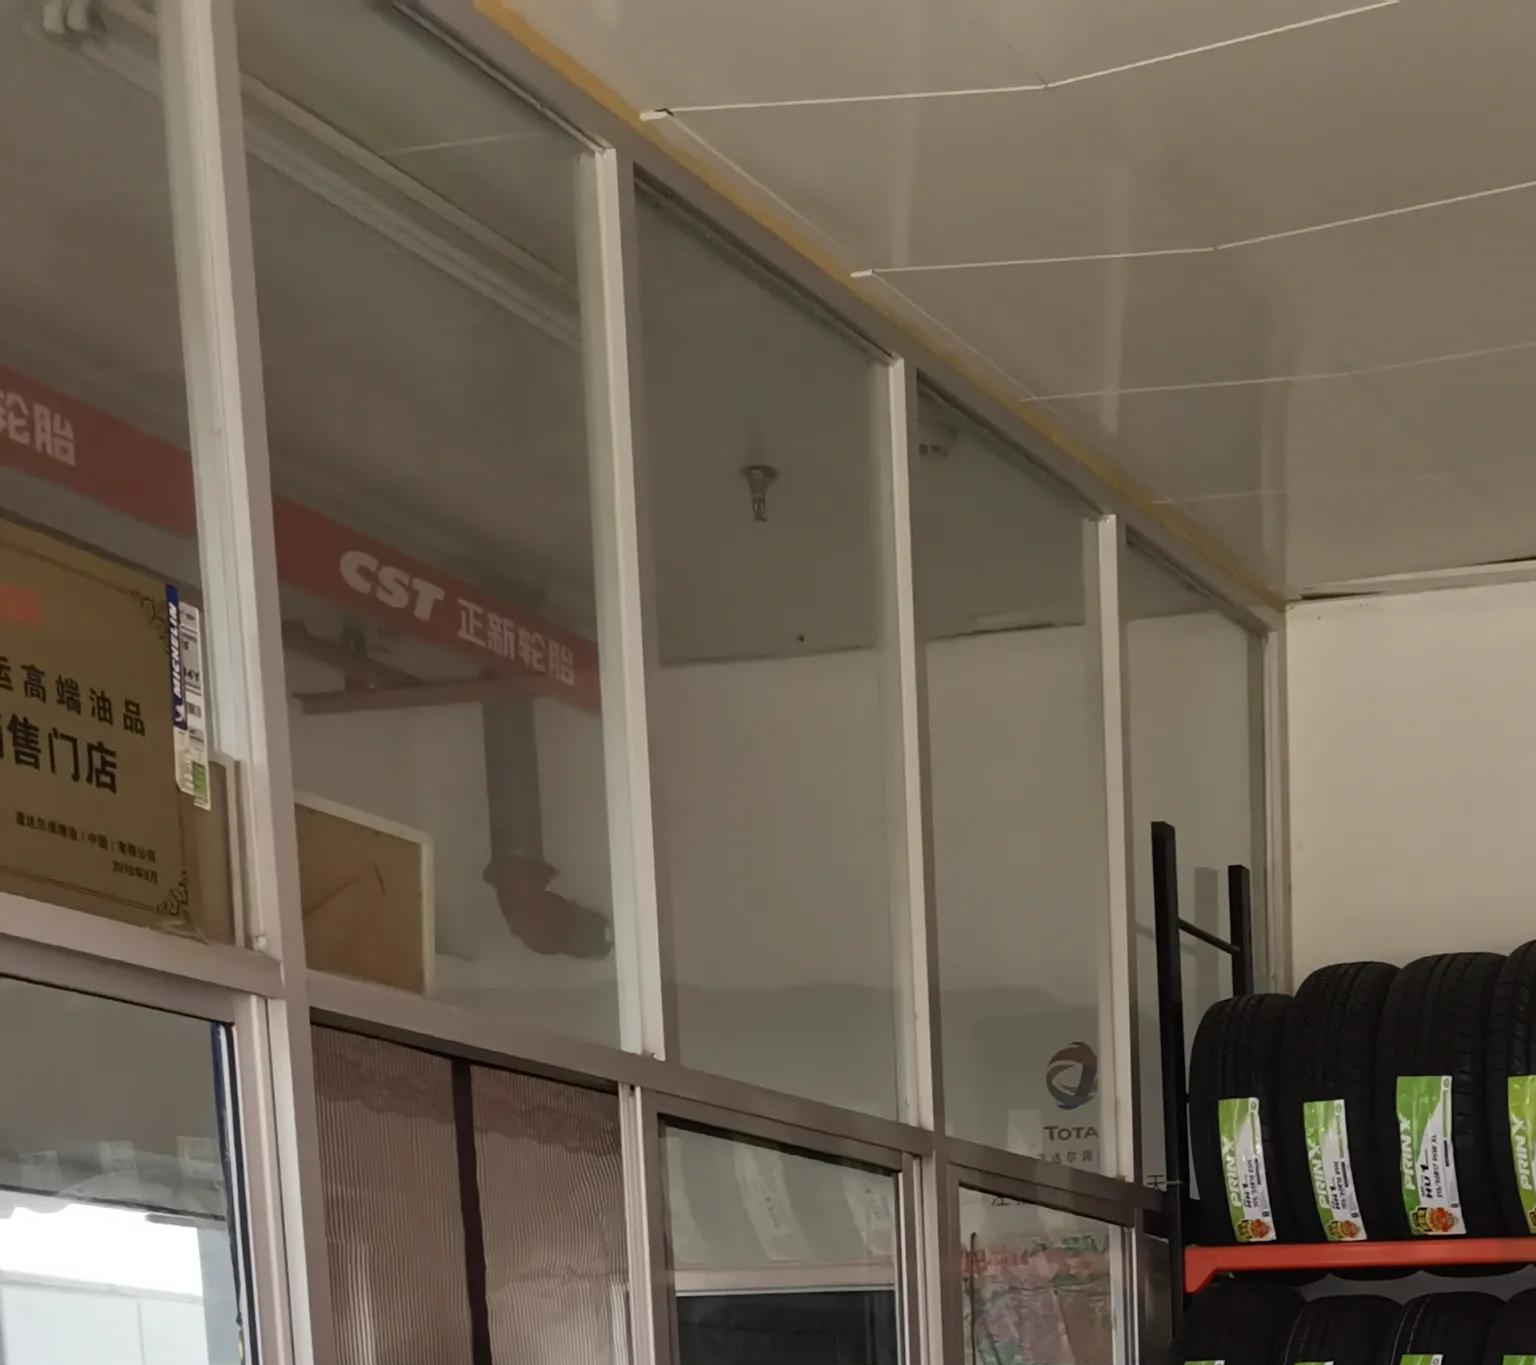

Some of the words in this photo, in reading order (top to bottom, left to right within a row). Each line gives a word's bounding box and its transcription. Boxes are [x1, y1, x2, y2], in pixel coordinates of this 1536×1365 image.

[168, 602, 182, 698] MICHELIN
[340, 551, 446, 622] CST
[457, 597, 574, 686] 正新轮胎
[0, 712, 117, 794] 售门店
[1043, 1126, 1099, 1141] TOTA
[1221, 1138, 1241, 1207] PRINX
[1306, 1130, 1331, 1208] PRINX
[1397, 1114, 1416, 1191] PRINX
[1510, 1113, 1532, 1191] PRINX
